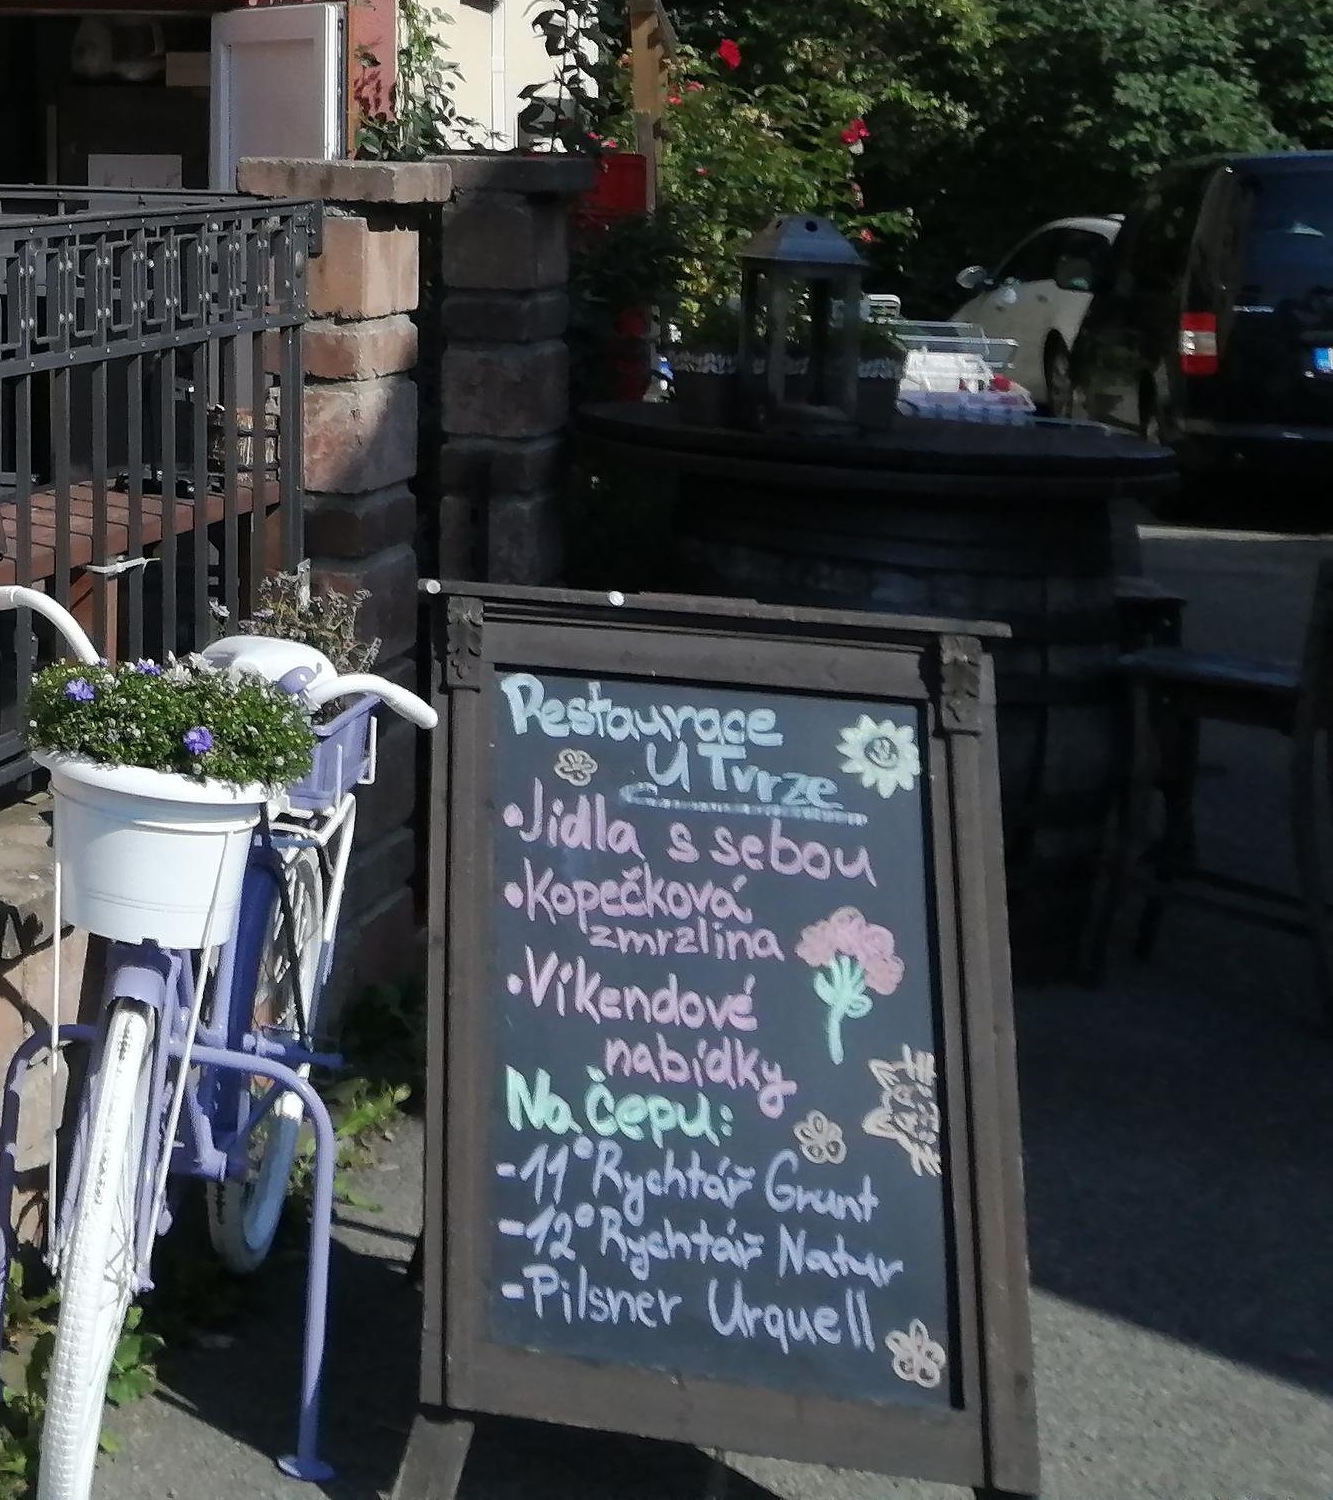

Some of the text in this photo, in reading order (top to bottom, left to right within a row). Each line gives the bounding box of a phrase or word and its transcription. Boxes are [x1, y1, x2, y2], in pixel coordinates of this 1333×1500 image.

[500, 671, 784, 748] Restaurace
[646, 740, 845, 811] U Tvrze
[666, 821, 700, 864] s
[708, 818, 878, 889] sebou
[523, 856, 754, 936] Kopečková
[588, 916, 786, 963] zmrzlina
[504, 1063, 584, 1136] Na
[764, 1148, 881, 1224] Grunt
[778, 1223, 905, 1290] Natur
[707, 1279, 878, 1355] Urquell
